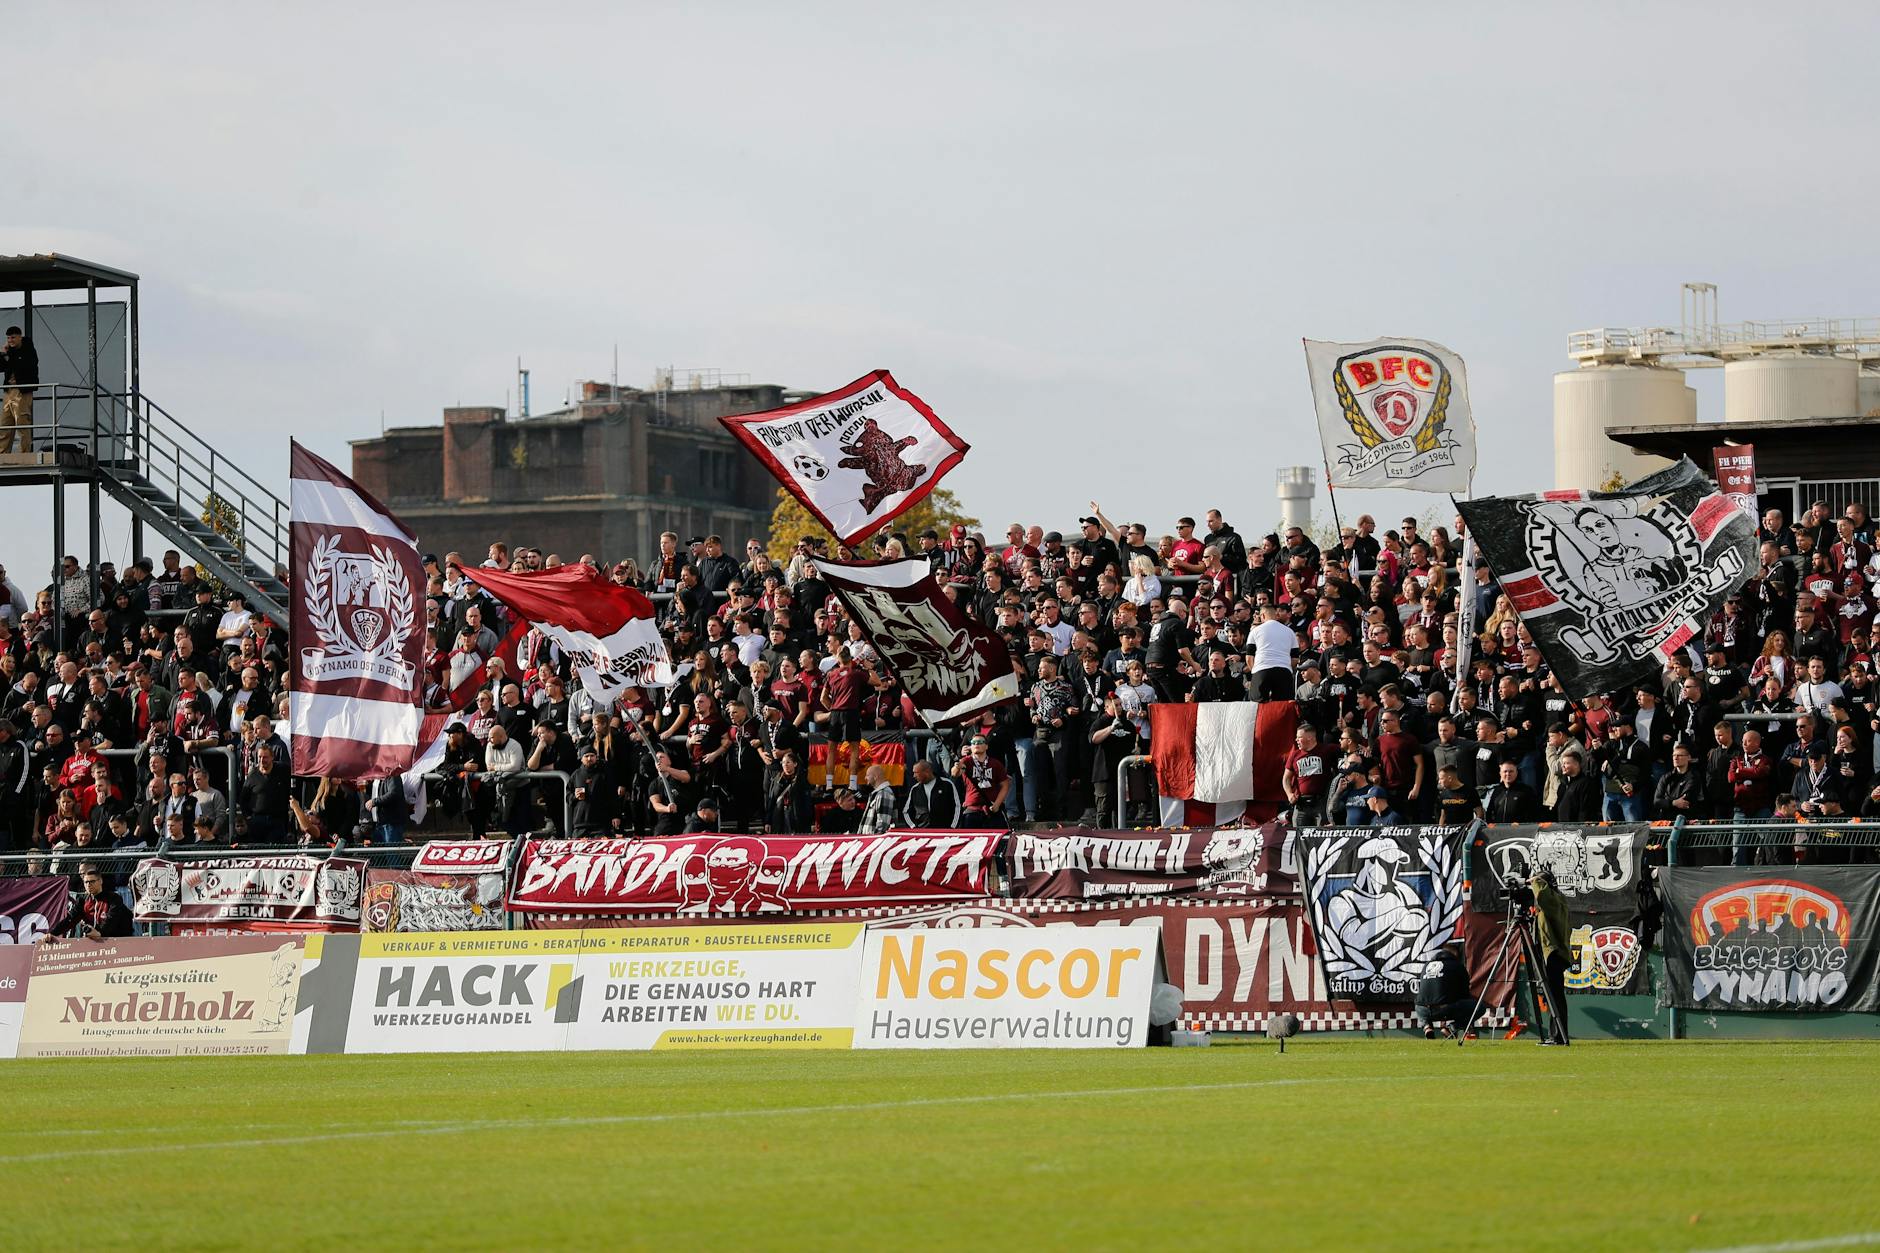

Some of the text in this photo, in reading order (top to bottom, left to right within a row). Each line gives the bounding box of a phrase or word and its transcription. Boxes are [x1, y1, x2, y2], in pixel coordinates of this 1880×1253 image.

[1348, 357, 1433, 388] BFC
[805, 414, 835, 439] DER
[1373, 440, 1411, 458] DYNAMO
[1409, 460, 1428, 473] since
[1429, 451, 1449, 463] 1966
[355, 612, 378, 623] BFC
[314, 660, 408, 684] DYNAMO OST BERLIN
[900, 650, 988, 696] BANDA
[516, 836, 989, 898] BANDA INVICTA
[219, 906, 275, 918] BERLIN
[324, 907, 345, 915] 1966
[1710, 892, 1830, 936] BFC
[38, 941, 71, 952] Ab hier
[382, 933, 832, 952] VERKAUF & VERMIETUNG BERATUNG REPARATUR BAUSTELLENSERVICE
[1595, 932, 1634, 948] BFC
[36, 962, 82, 973] Falkenberger
[133, 954, 155, 963] Berlin
[37, 946, 117, 962] 15 Minuten zu Fuß
[1693, 944, 1848, 971] BLACKBOYS
[608, 959, 747, 978] WERKZEUGE,
[875, 934, 1142, 1000] Nascor
[104, 970, 218, 988] Kiezgaststätte
[374, 963, 539, 1008] HACK
[1692, 970, 1848, 1005] DYNAMO
[604, 980, 817, 1001] DIE GENAUSO HART
[59, 991, 255, 1023] Nudelholz
[601, 1003, 800, 1023] ARBEITEN WIE DU.
[373, 1012, 532, 1026] WERKZEUGHANDEL
[870, 1009, 1134, 1046] Hausverwaltung
[82, 1024, 226, 1038] Hausgemachte deutsche Küche
[669, 1033, 822, 1045] www.hack-werkzeughandel.de
[183, 1047, 201, 1055] Tel.
[203, 1046, 221, 1055] 030
[222, 1046, 241, 1055] 925
[242, 1046, 255, 1055] 25
[256, 1045, 269, 1055] 07
